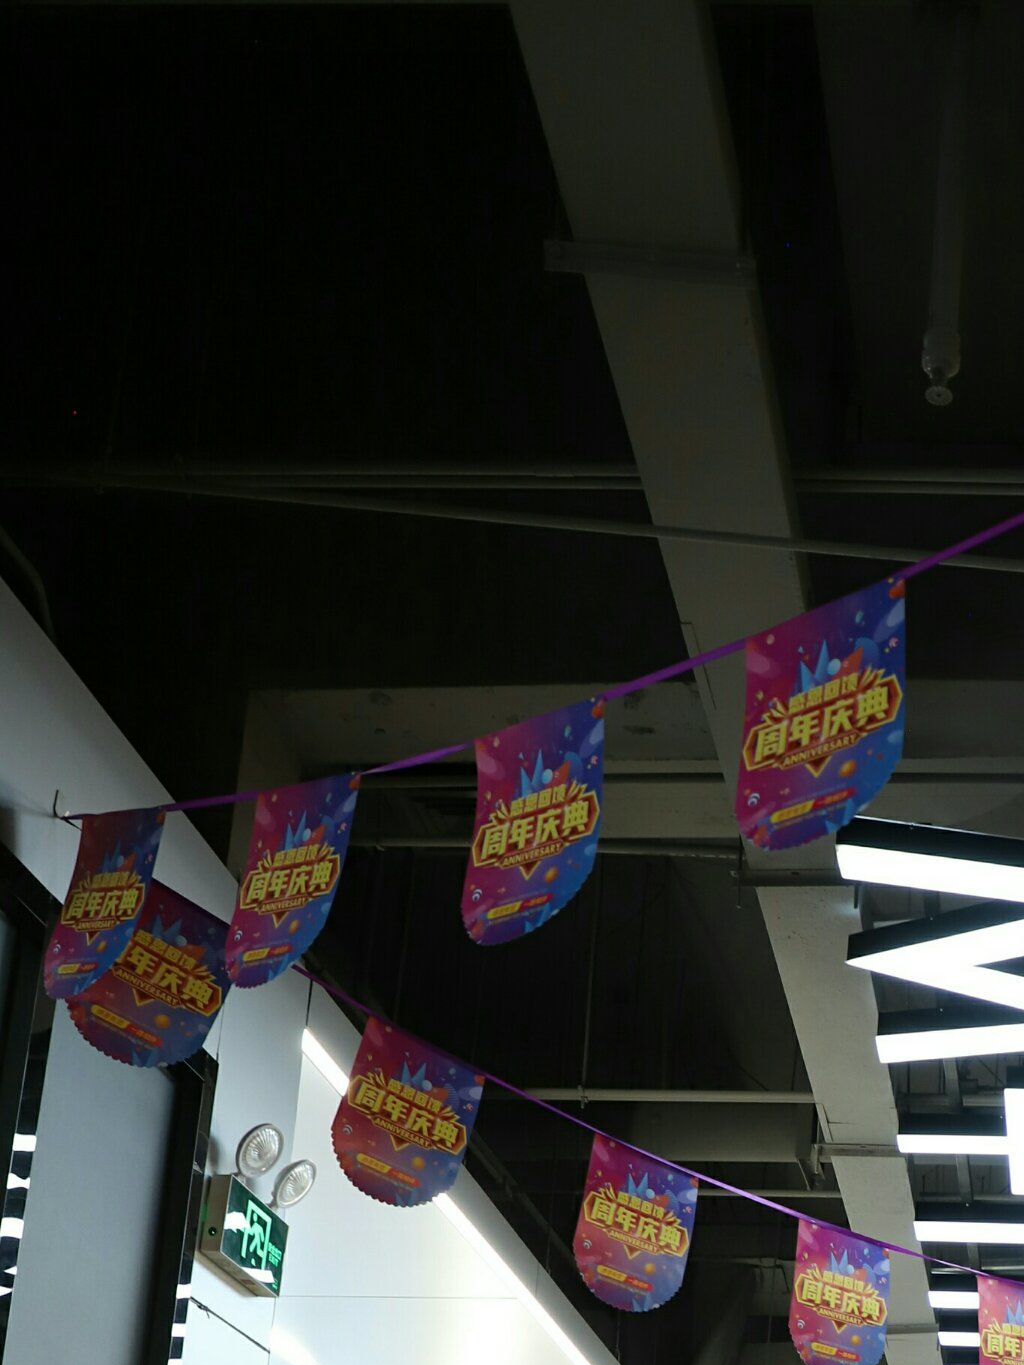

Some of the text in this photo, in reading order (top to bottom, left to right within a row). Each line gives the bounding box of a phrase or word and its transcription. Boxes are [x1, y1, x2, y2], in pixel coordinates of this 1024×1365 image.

[755, 685, 888, 763] 周年庆典
[783, 733, 857, 767] ANNIVERSARY
[481, 800, 589, 860] 周年庆典
[502, 842, 561, 866] ANNIVERSARY
[247, 861, 333, 901] 周年庆典
[67, 890, 138, 919] 周年庆典
[127, 946, 214, 1009] 年庆典
[355, 1083, 459, 1146] 周年庆典
[374, 1118, 430, 1148] ANNIVERSARY
[591, 1198, 681, 1250] 周年庆典
[802, 1279, 880, 1320] 周年庆典
